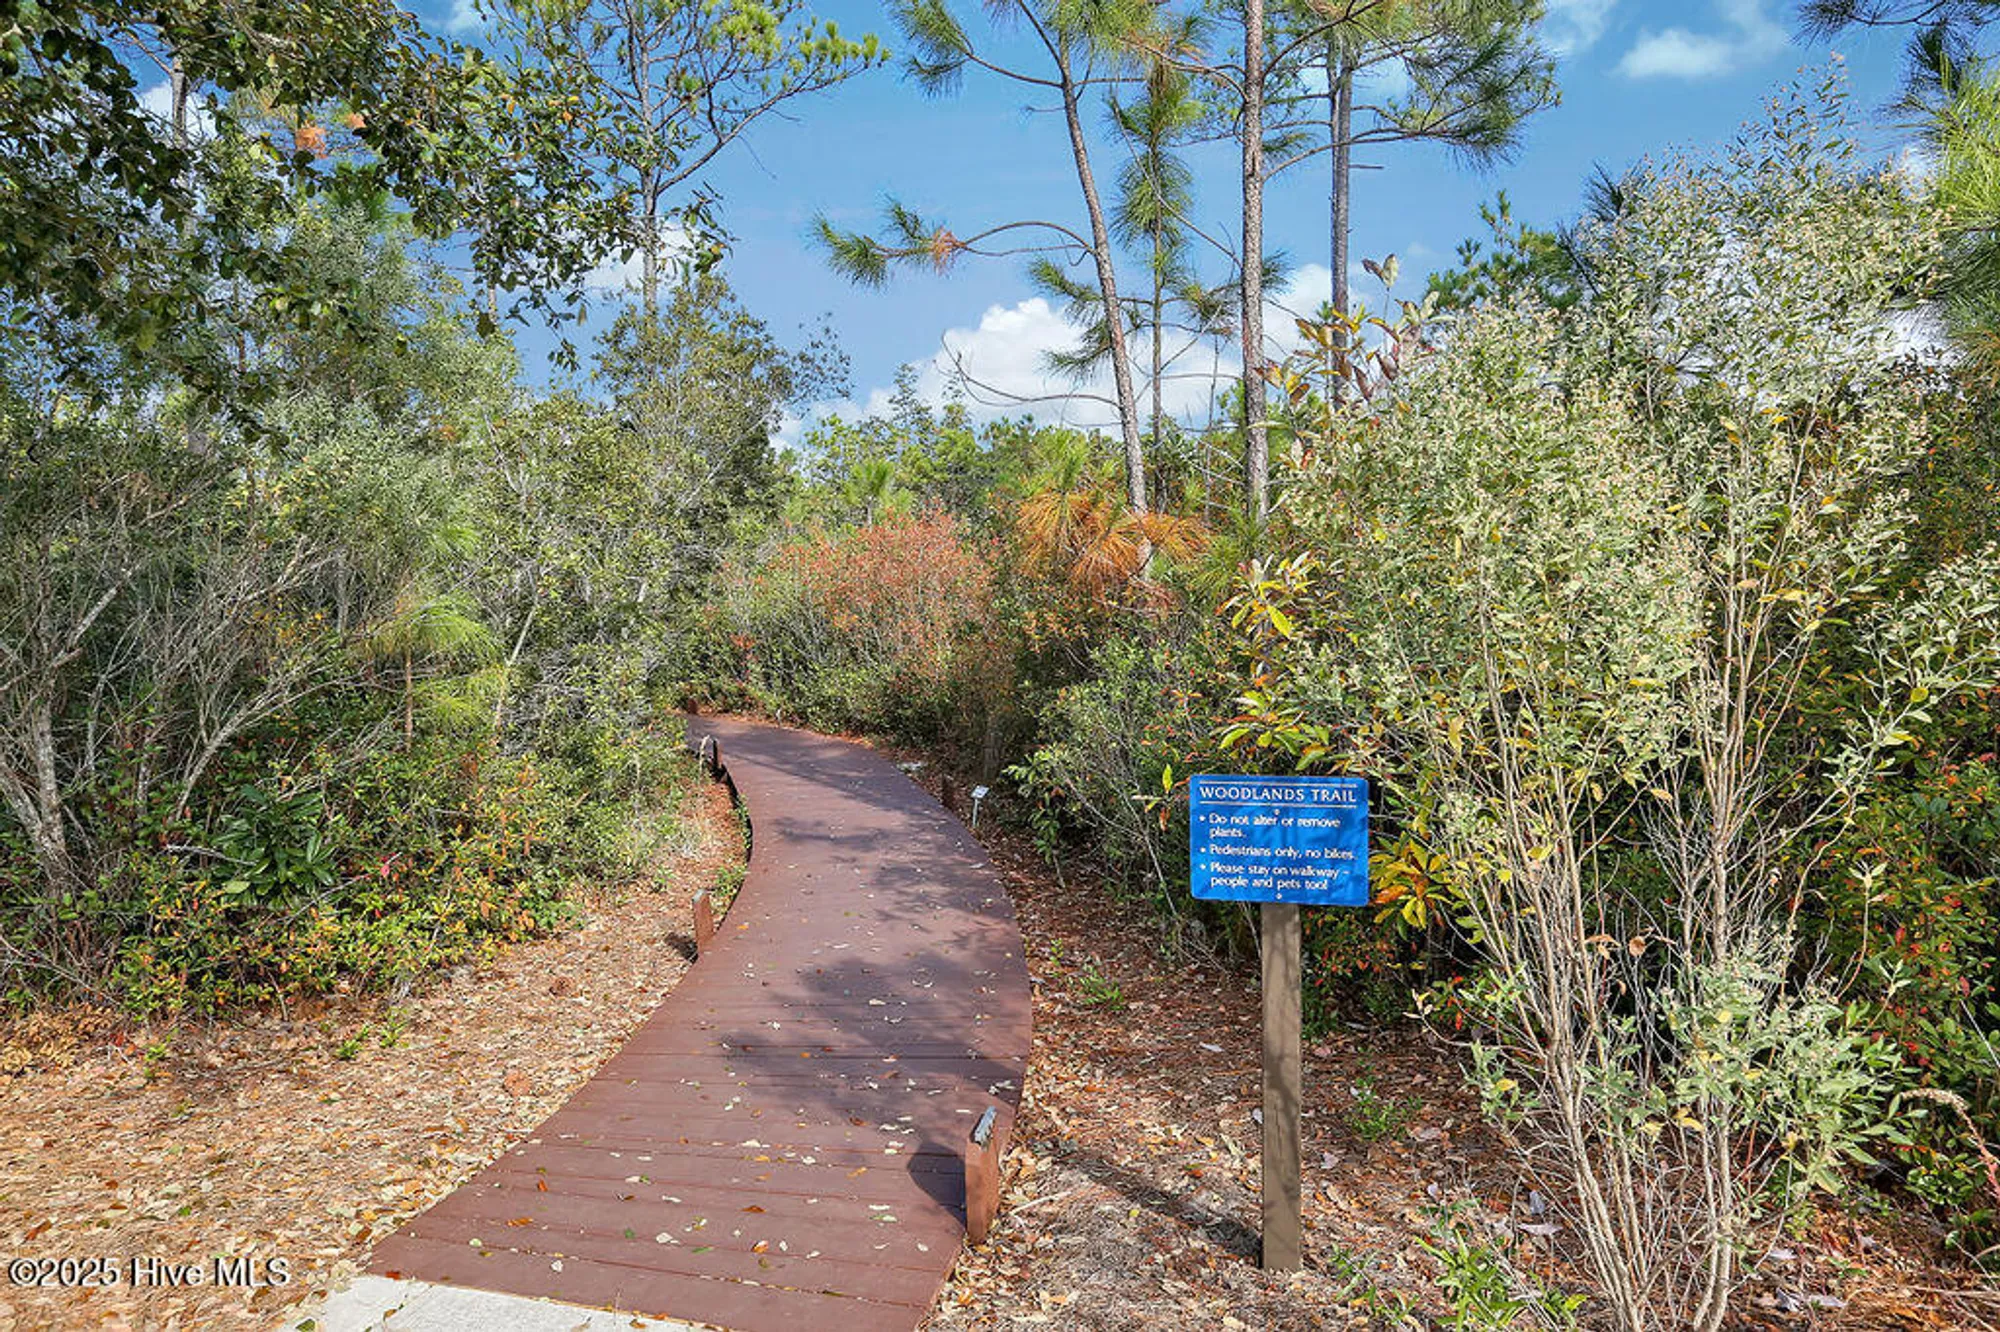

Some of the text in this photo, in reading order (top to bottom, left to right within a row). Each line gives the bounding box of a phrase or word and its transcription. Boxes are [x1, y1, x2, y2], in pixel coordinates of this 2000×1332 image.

[1200, 787, 1357, 802] WOODLANDS TRAIL
[1209, 813, 1341, 828] Do not alter or remove
[1209, 827, 1246, 838] plants.
[1209, 844, 1357, 860] Pedestrians only, no bikes.
[1210, 862, 1244, 874] Please
[1248, 864, 1270, 876] stay
[1273, 866, 1288, 875] on
[1291, 866, 1339, 878] walkway
[1210, 876, 1248, 887] people
[1252, 878, 1272, 888] and
[1277, 879, 1301, 890] pets
